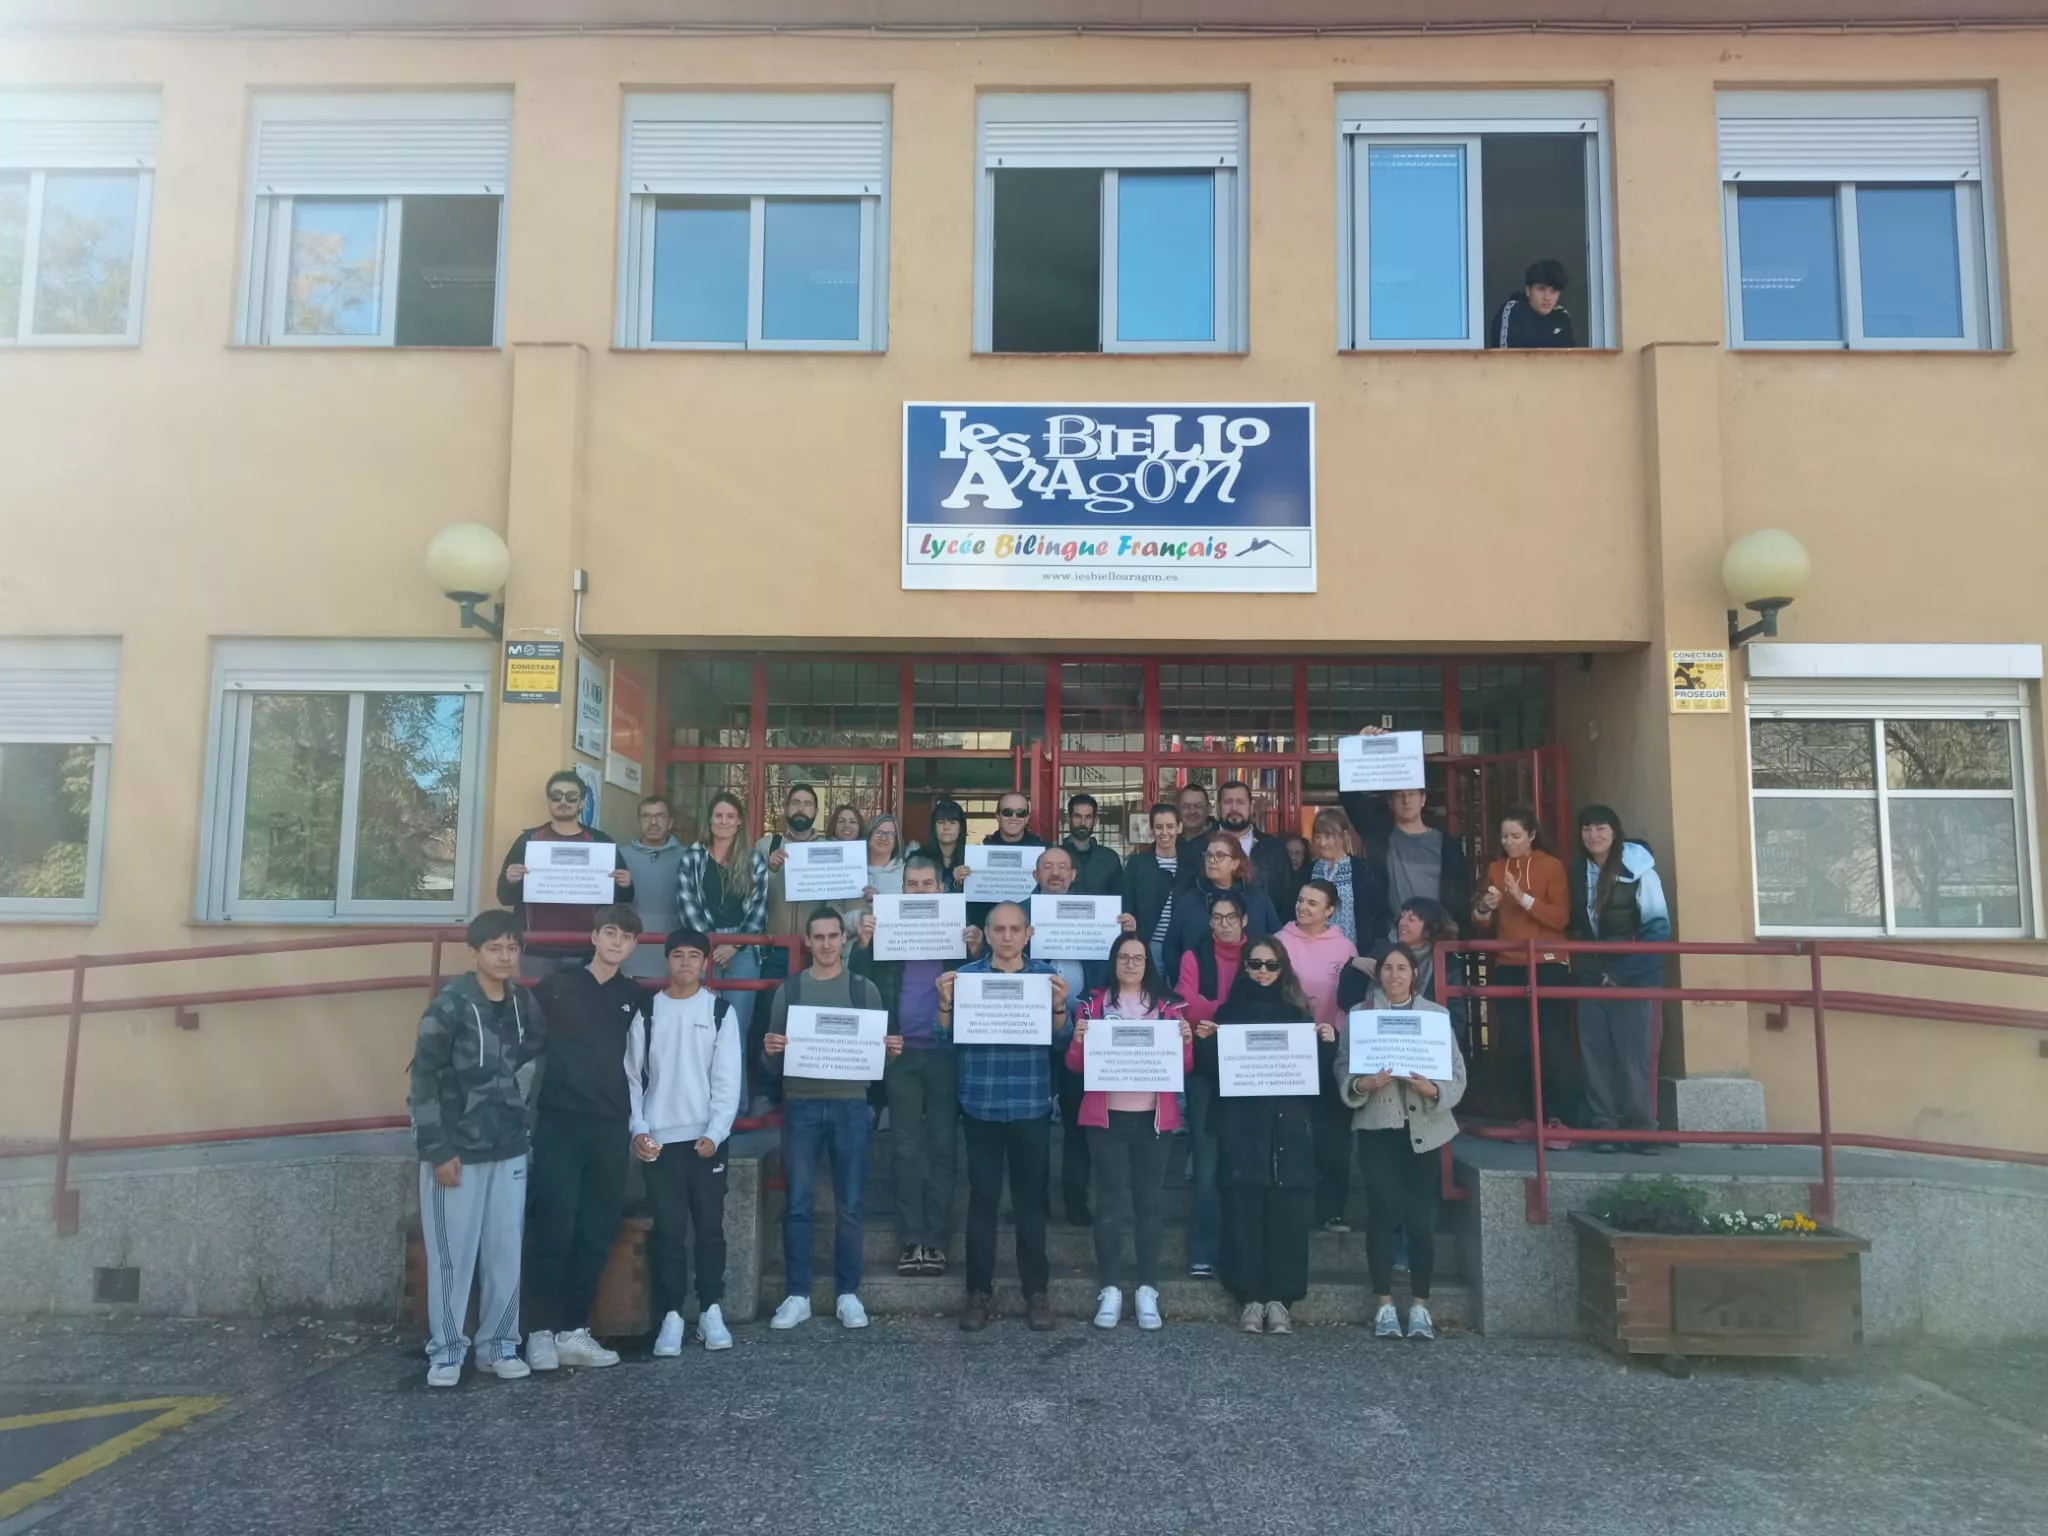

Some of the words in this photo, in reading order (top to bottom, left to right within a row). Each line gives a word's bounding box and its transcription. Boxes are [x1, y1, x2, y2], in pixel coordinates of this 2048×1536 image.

[920, 533, 986, 559] Lycée
[994, 534, 1109, 562] Bilingue
[1117, 535, 1228, 560] Français
[1042, 572, 1178, 583] www.iesbielloaragon.es
